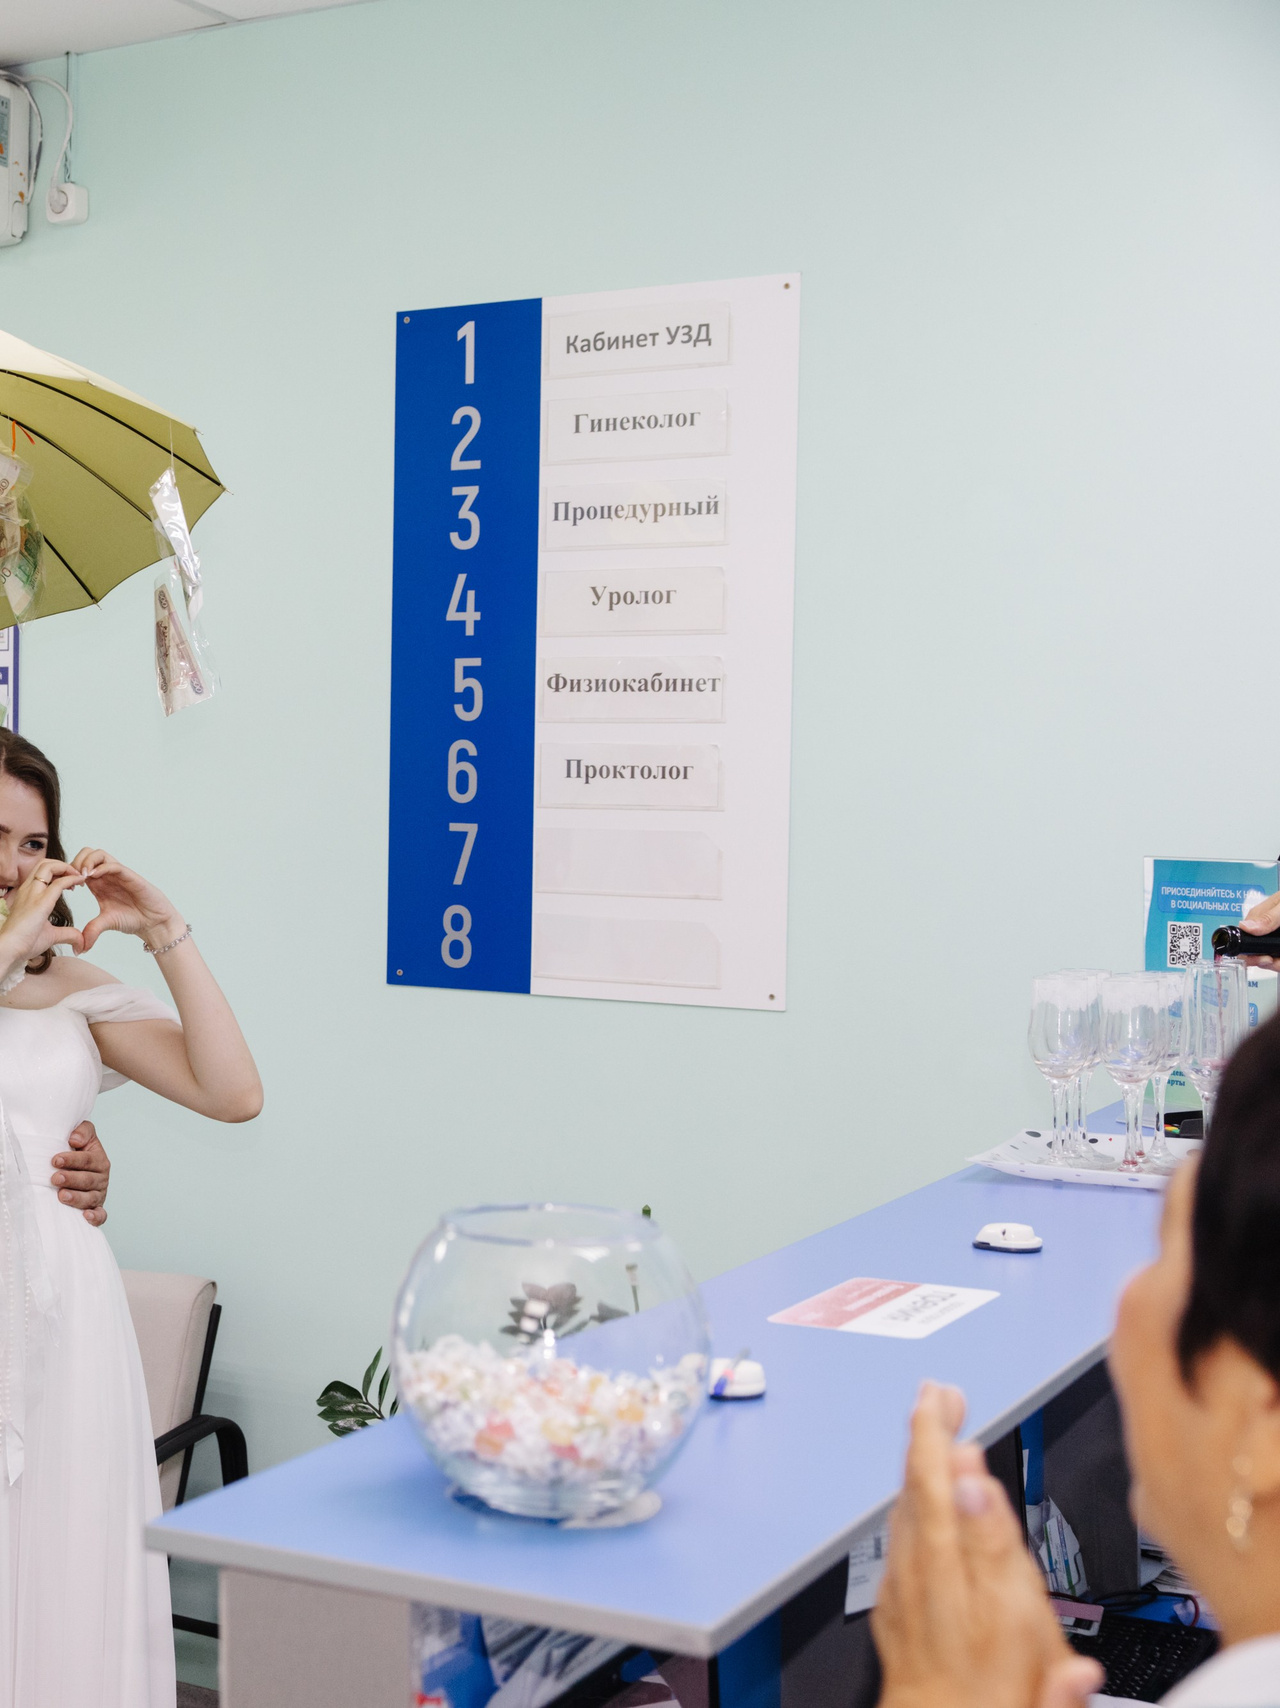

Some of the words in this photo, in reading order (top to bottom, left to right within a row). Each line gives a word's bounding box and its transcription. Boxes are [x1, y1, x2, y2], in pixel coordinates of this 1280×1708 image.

[456, 320, 476, 385] 1
[565, 330, 659, 354] Кабинет
[665, 323, 712, 346] УЗД
[450, 405, 482, 471] 2
[573, 411, 701, 434] Гинеколог
[449, 485, 481, 550] 3
[552, 495, 720, 527] Процедурный
[446, 573, 481, 637] 4
[589, 585, 677, 611] Уролог
[453, 657, 483, 722] 5
[546, 672, 721, 693] Физиокабинет
[447, 739, 478, 804] 6
[564, 758, 695, 785] Проктолог
[449, 822, 479, 885] 7
[1161, 886, 1235, 898] ПРИСОЕДИНЯЙТЕСЬ
[1170, 900, 1175, 908] В
[1177, 900, 1229, 911] СОЦИАЛЬНЫХ
[441, 904, 472, 969] 8
